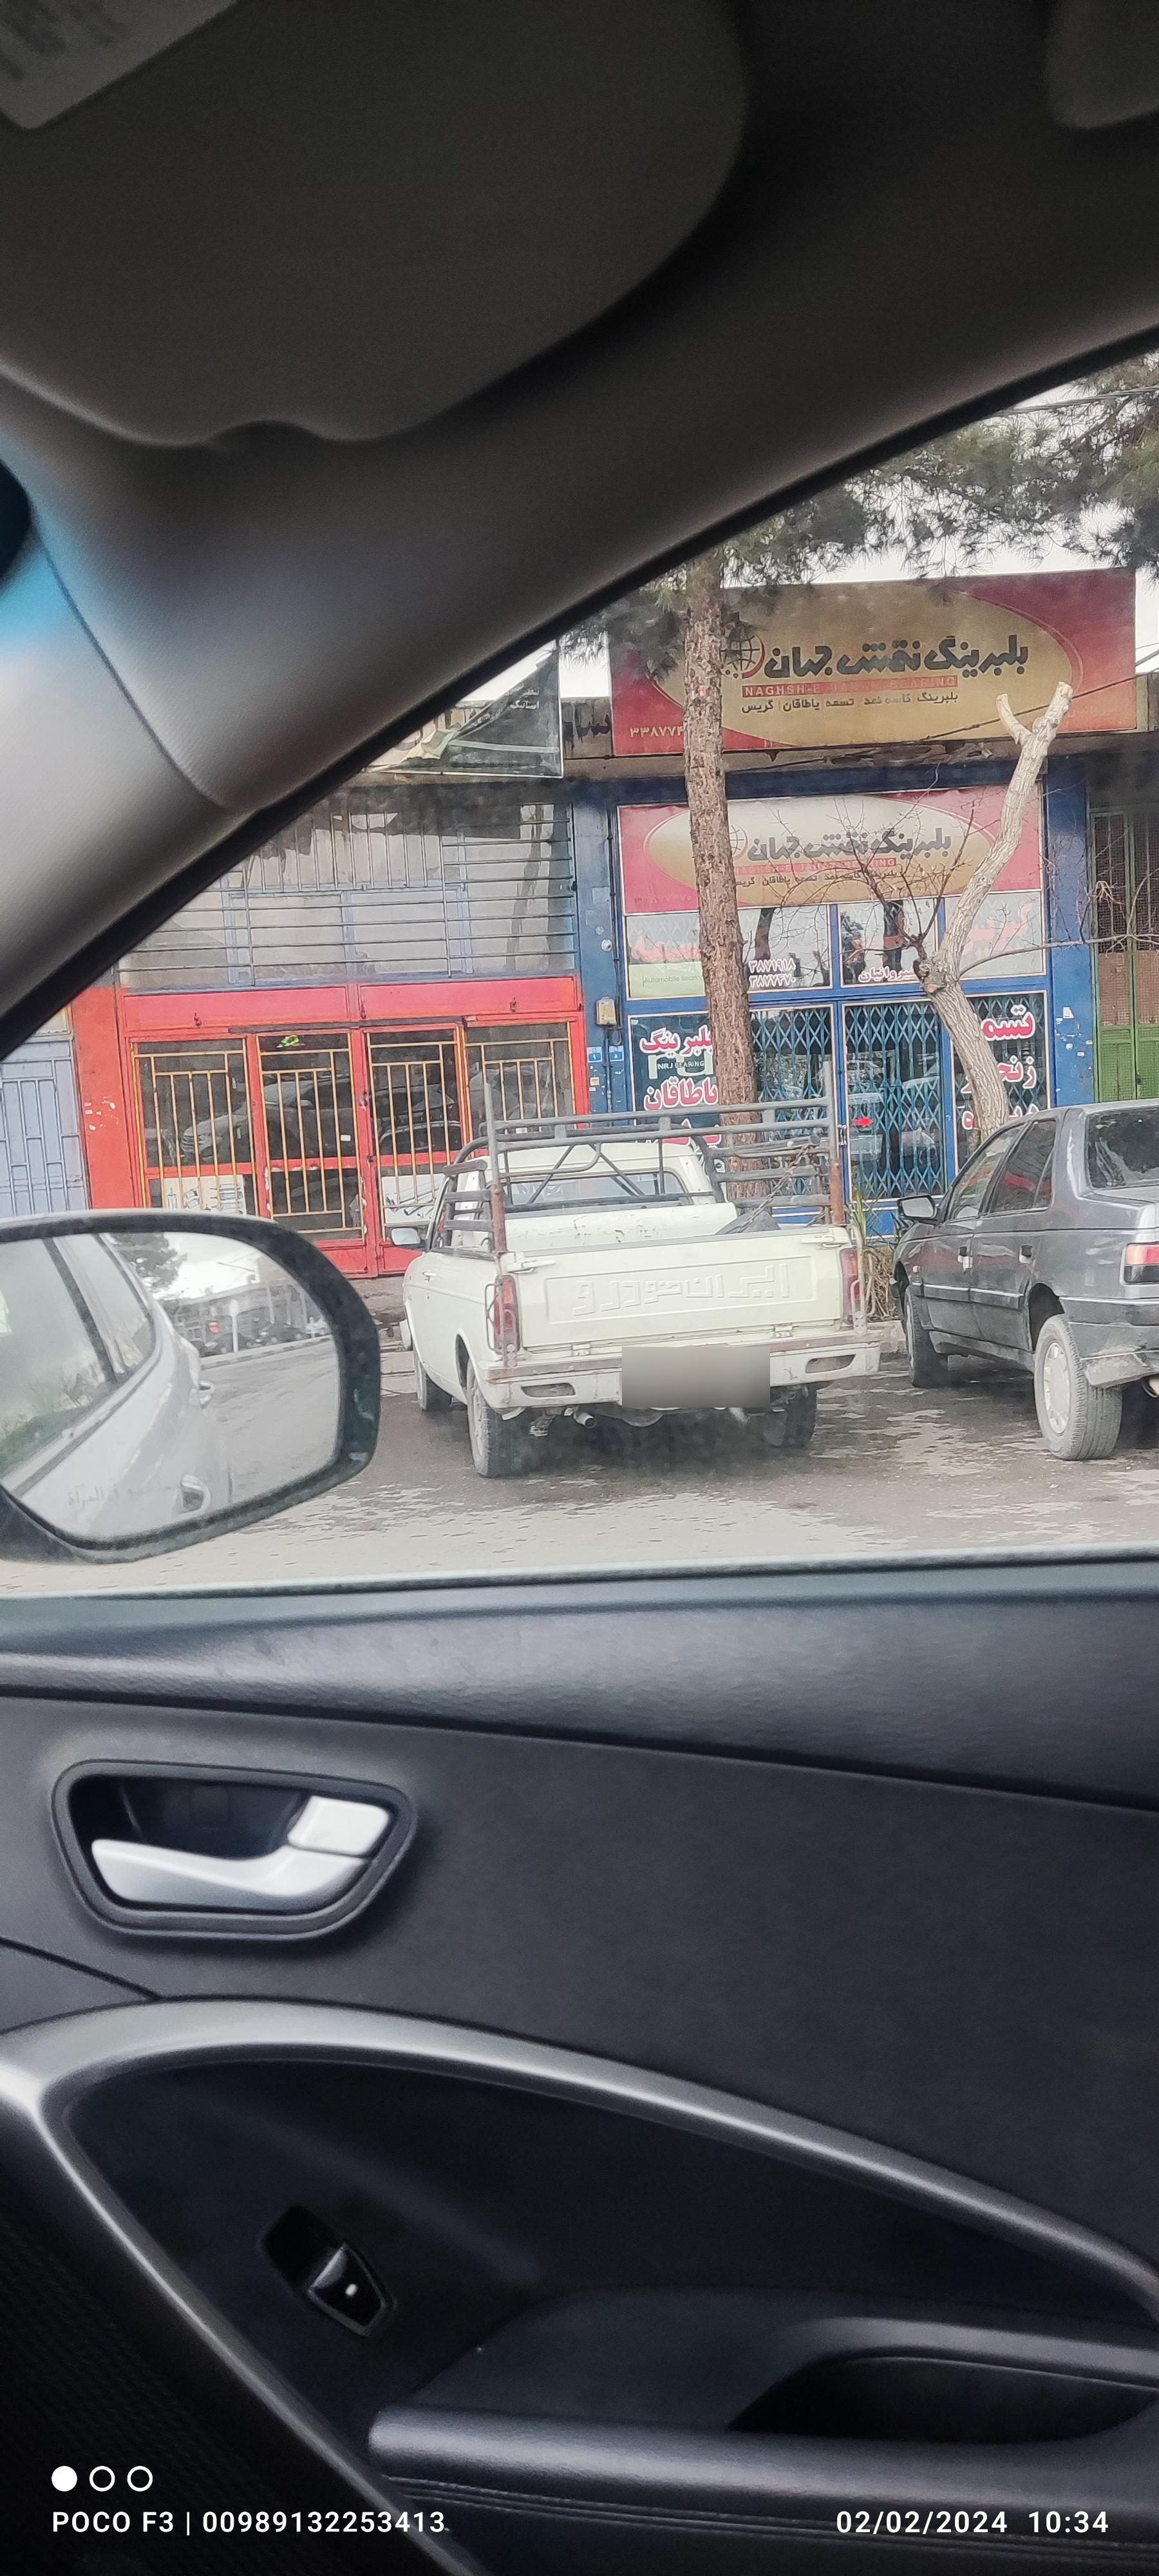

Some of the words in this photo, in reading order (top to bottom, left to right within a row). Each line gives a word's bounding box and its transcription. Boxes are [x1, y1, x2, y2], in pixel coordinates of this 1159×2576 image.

[764, 645, 833, 678] جهان
[836, 639, 921, 674] نقش
[925, 634, 1029, 678] بلبرینگ
[745, 684, 822, 696] NAGHSH-E
[917, 692, 958, 704] بلبرینگ
[742, 699, 774, 714] گریس
[783, 699, 820, 712] یاطاقان
[825, 698, 854, 708] تسمه
[630, 725, 685, 738] ۳۳۸۷۷۴
[748, 836, 800, 861] جهان
[804, 831, 869, 856] نقش
[871, 828, 951, 859] بلبرینگ
[748, 958, 796, 973] ۳۸۷۱۹۱۸
[684, 1264, 790, 1298] ایران
